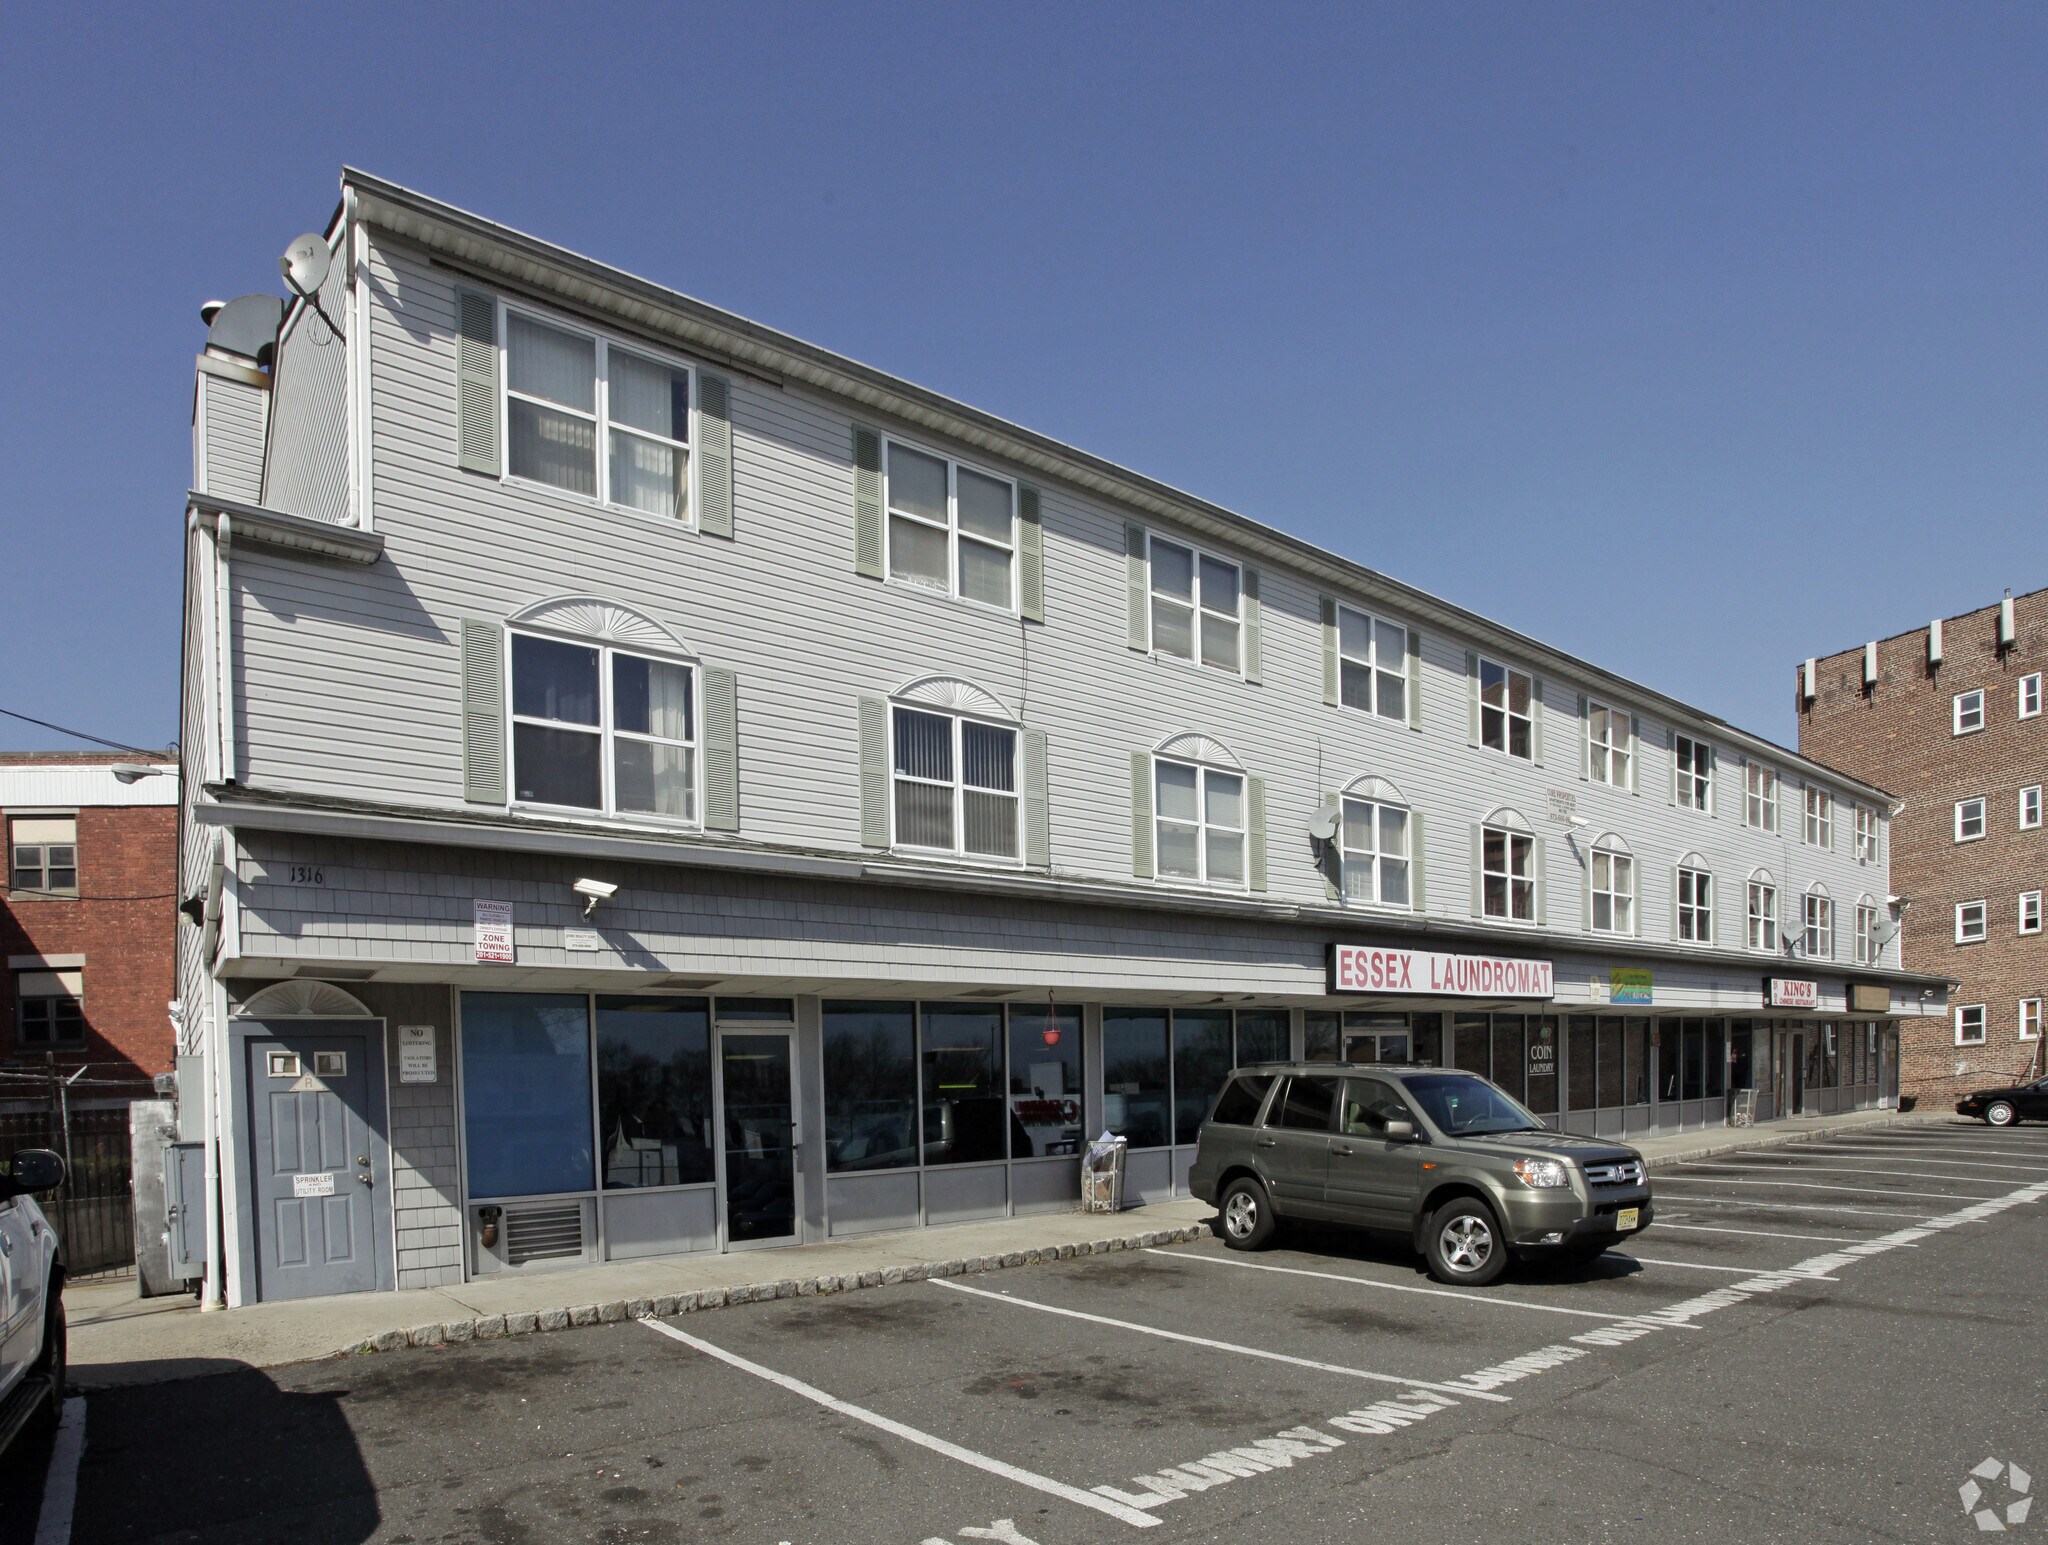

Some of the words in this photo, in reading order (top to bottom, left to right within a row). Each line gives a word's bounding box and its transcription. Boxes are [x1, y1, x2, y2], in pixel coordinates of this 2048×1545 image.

[291, 867, 323, 884] 1316
[476, 902, 511, 912] WARNING
[483, 934, 505, 943] ZONE
[478, 942, 511, 951] TOWING
[1340, 950, 1412, 988] ESSEX
[1431, 956, 1550, 993] LAUNDROMAT
[1784, 981, 1812, 997] KING'S
[410, 1029, 424, 1038] NO
[1531, 1045, 1553, 1060] COIN
[1529, 1063, 1555, 1073] LAUNDRY
[305, 1077, 313, 1088] R
[296, 1175, 333, 1184] SPRINKLER
[1441, 1344, 1591, 1391] LAUNDRY
[1569, 1320, 1664, 1346] ONLY
[1089, 1425, 1347, 1510] LAUNDRY
[1327, 1389, 1461, 1434] ONLY
